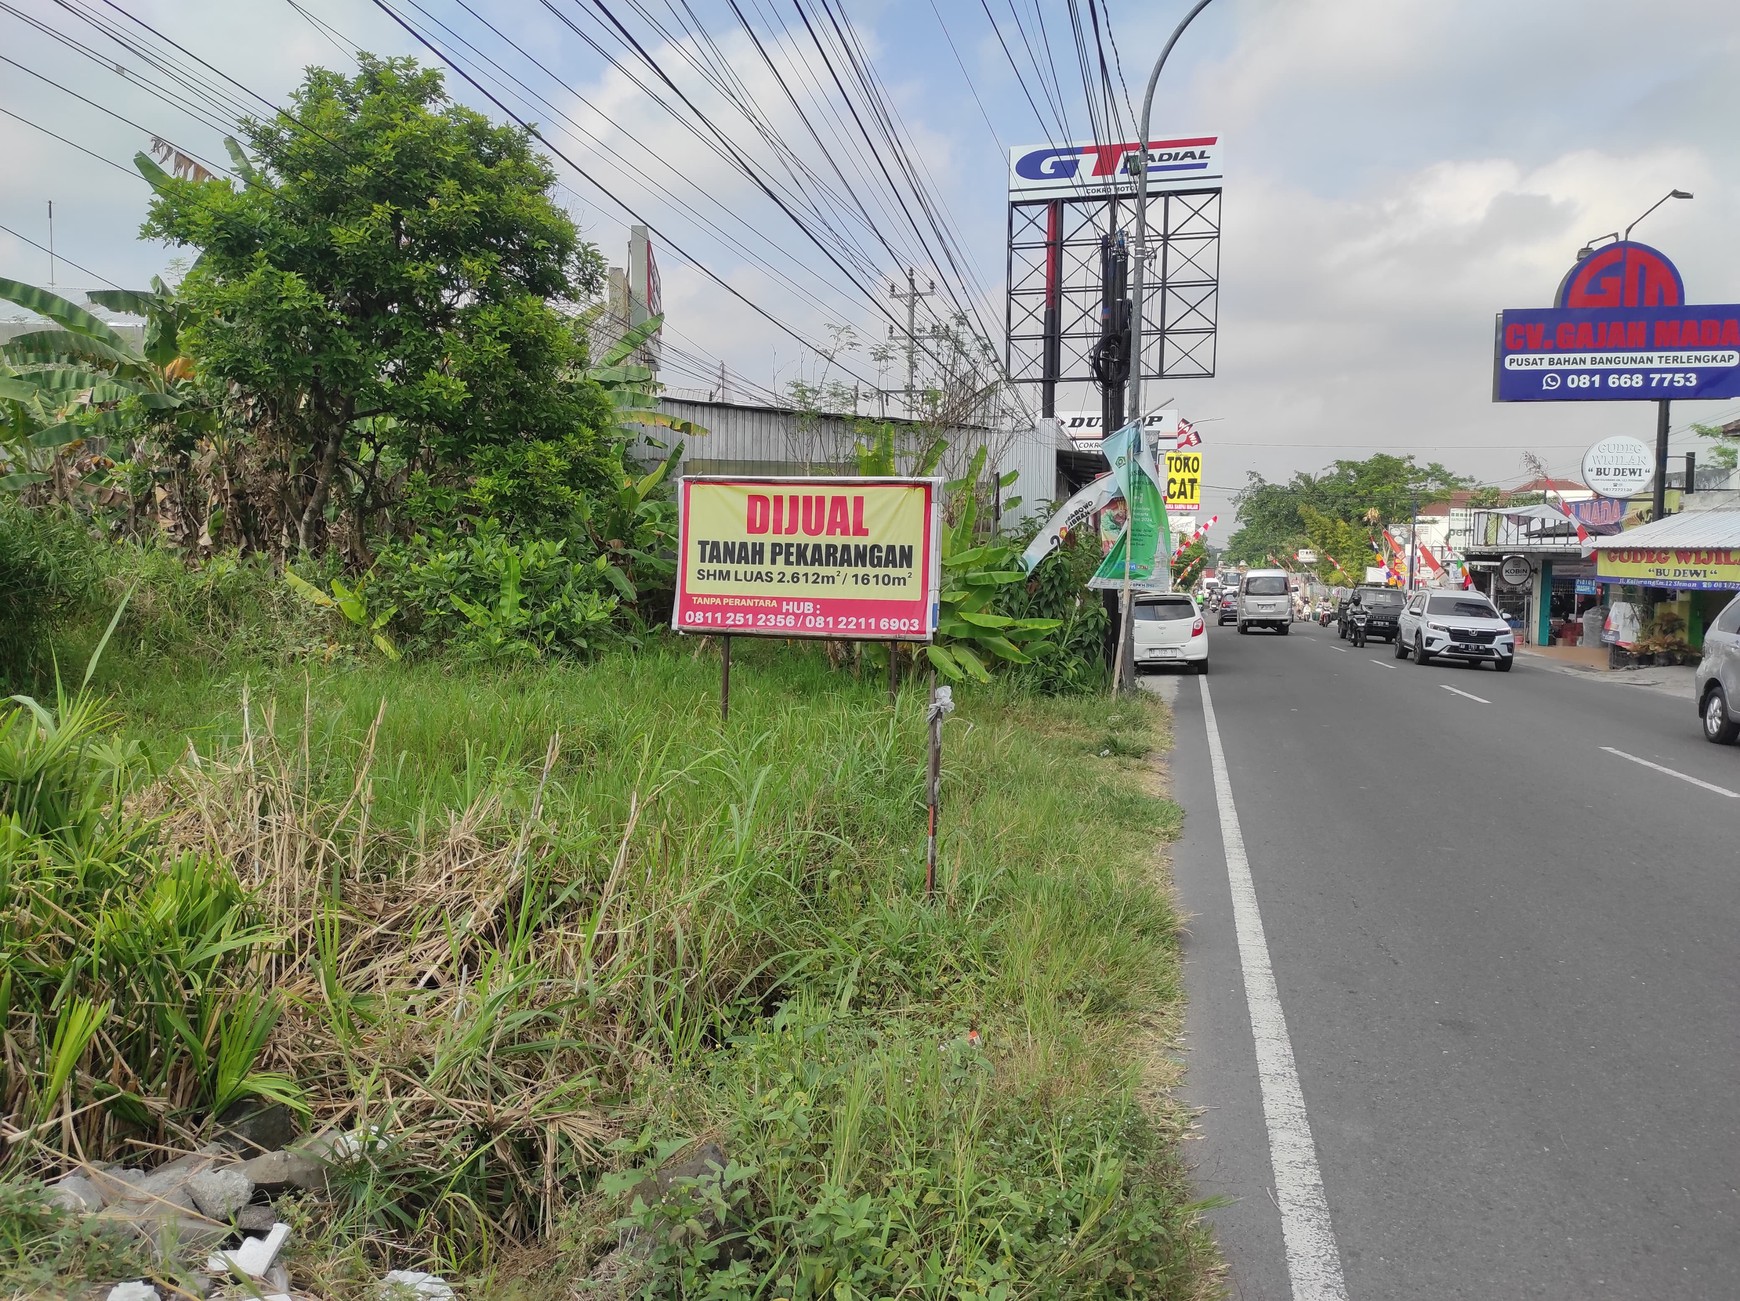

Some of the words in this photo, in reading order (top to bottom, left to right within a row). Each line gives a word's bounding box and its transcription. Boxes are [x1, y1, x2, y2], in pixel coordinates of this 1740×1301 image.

[1654, 319, 1740, 347] MADA
[1509, 357, 1545, 367] PUSAT
[1549, 356, 1586, 366] BAHAN
[1590, 355, 1654, 366] BANGUNAN
[1657, 354, 1735, 365] TERLENGKAP
[1567, 374, 1600, 388] 081
[1608, 373, 1643, 388] 668
[1649, 373, 1697, 387] 7753
[1167, 456, 1200, 474] TOKO
[1167, 477, 1198, 500] CAT
[746, 494, 869, 537] DIJUAL
[697, 540, 765, 565] TANAH
[770, 543, 914, 569] PEKARANGAN
[1607, 549, 1671, 564] GUDEG
[696, 569, 731, 582] SHM
[734, 570, 774, 583] LUAS
[692, 596, 722, 606] TANPA
[722, 597, 778, 608] PERANTARA
